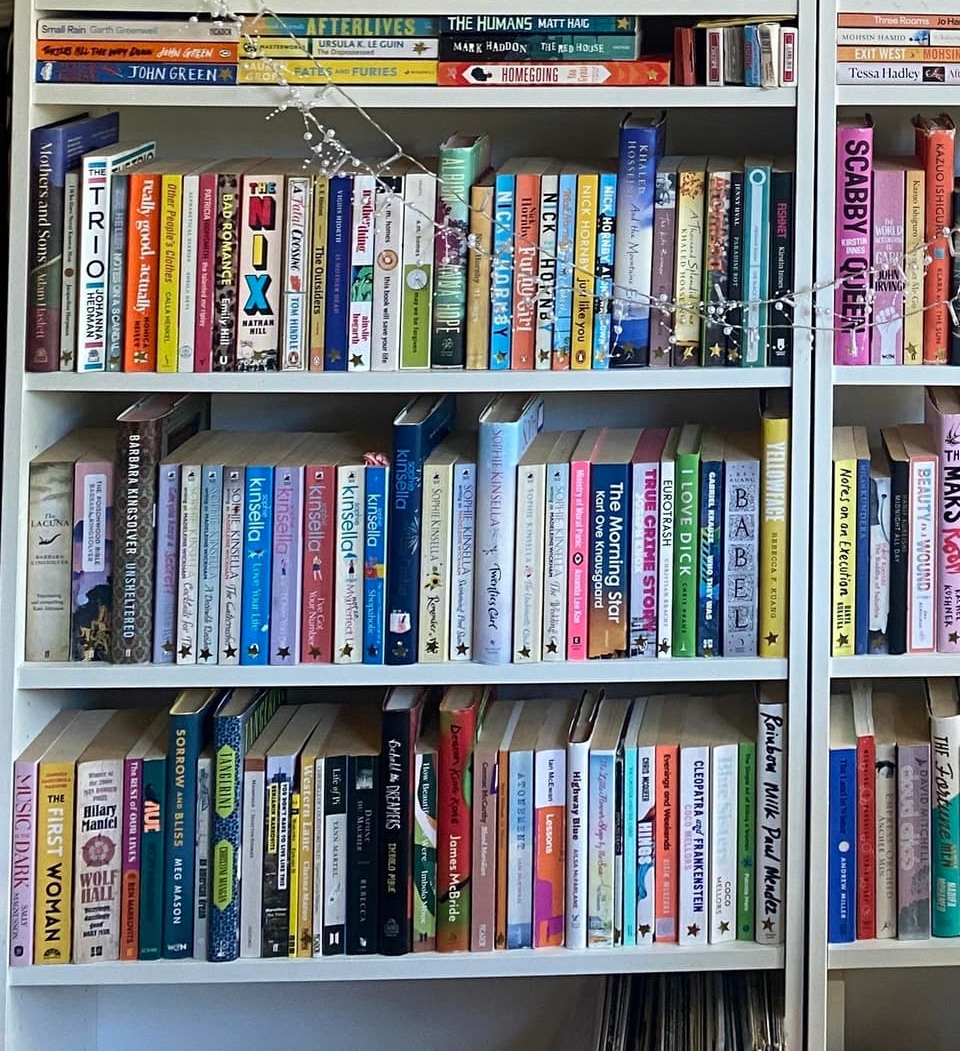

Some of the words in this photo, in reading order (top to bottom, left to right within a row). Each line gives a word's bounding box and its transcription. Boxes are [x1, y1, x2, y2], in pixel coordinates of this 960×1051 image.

[306, 19, 414, 35] AFTERLIVES
[448, 17, 473, 29] THE
[477, 16, 532, 30] HUMANS
[538, 19, 565, 28] MATT
[568, 19, 589, 29] HAIG
[128, 65, 166, 79] JOHN
[169, 66, 217, 81] GREEN
[502, 68, 558, 82] HOMEGOING
[848, 68, 877, 79] Tessa
[880, 68, 919, 80] Hadley
[855, 49, 876, 60] EXIT
[879, 49, 905, 60] WEST
[221, 193, 232, 218] BAD
[844, 139, 869, 234] SCABBY
[87, 186, 104, 277] TRIO
[221, 220, 232, 286] ROMANCE
[129, 434, 140, 483] BARBARA
[248, 478, 264, 542] kinsella
[609, 482, 623, 512] The
[663, 479, 672, 547] EUROTRASH
[680, 483, 692, 525] LOVE
[127, 488, 137, 555] KINGSOLVER
[605, 519, 622, 586] Morning
[679, 533, 691, 575] DICK
[733, 488, 748, 630] BABEL
[125, 563, 135, 638] UNSHELTERED
[607, 591, 622, 623] Star
[175, 730, 186, 789] SORROW
[572, 772, 581, 815] Highway
[694, 760, 703, 817] CLEOPATRA
[544, 814, 554, 854] Lessons
[693, 839, 703, 913] FRANKENSTEIN
[44, 863, 62, 942] WOMAN
